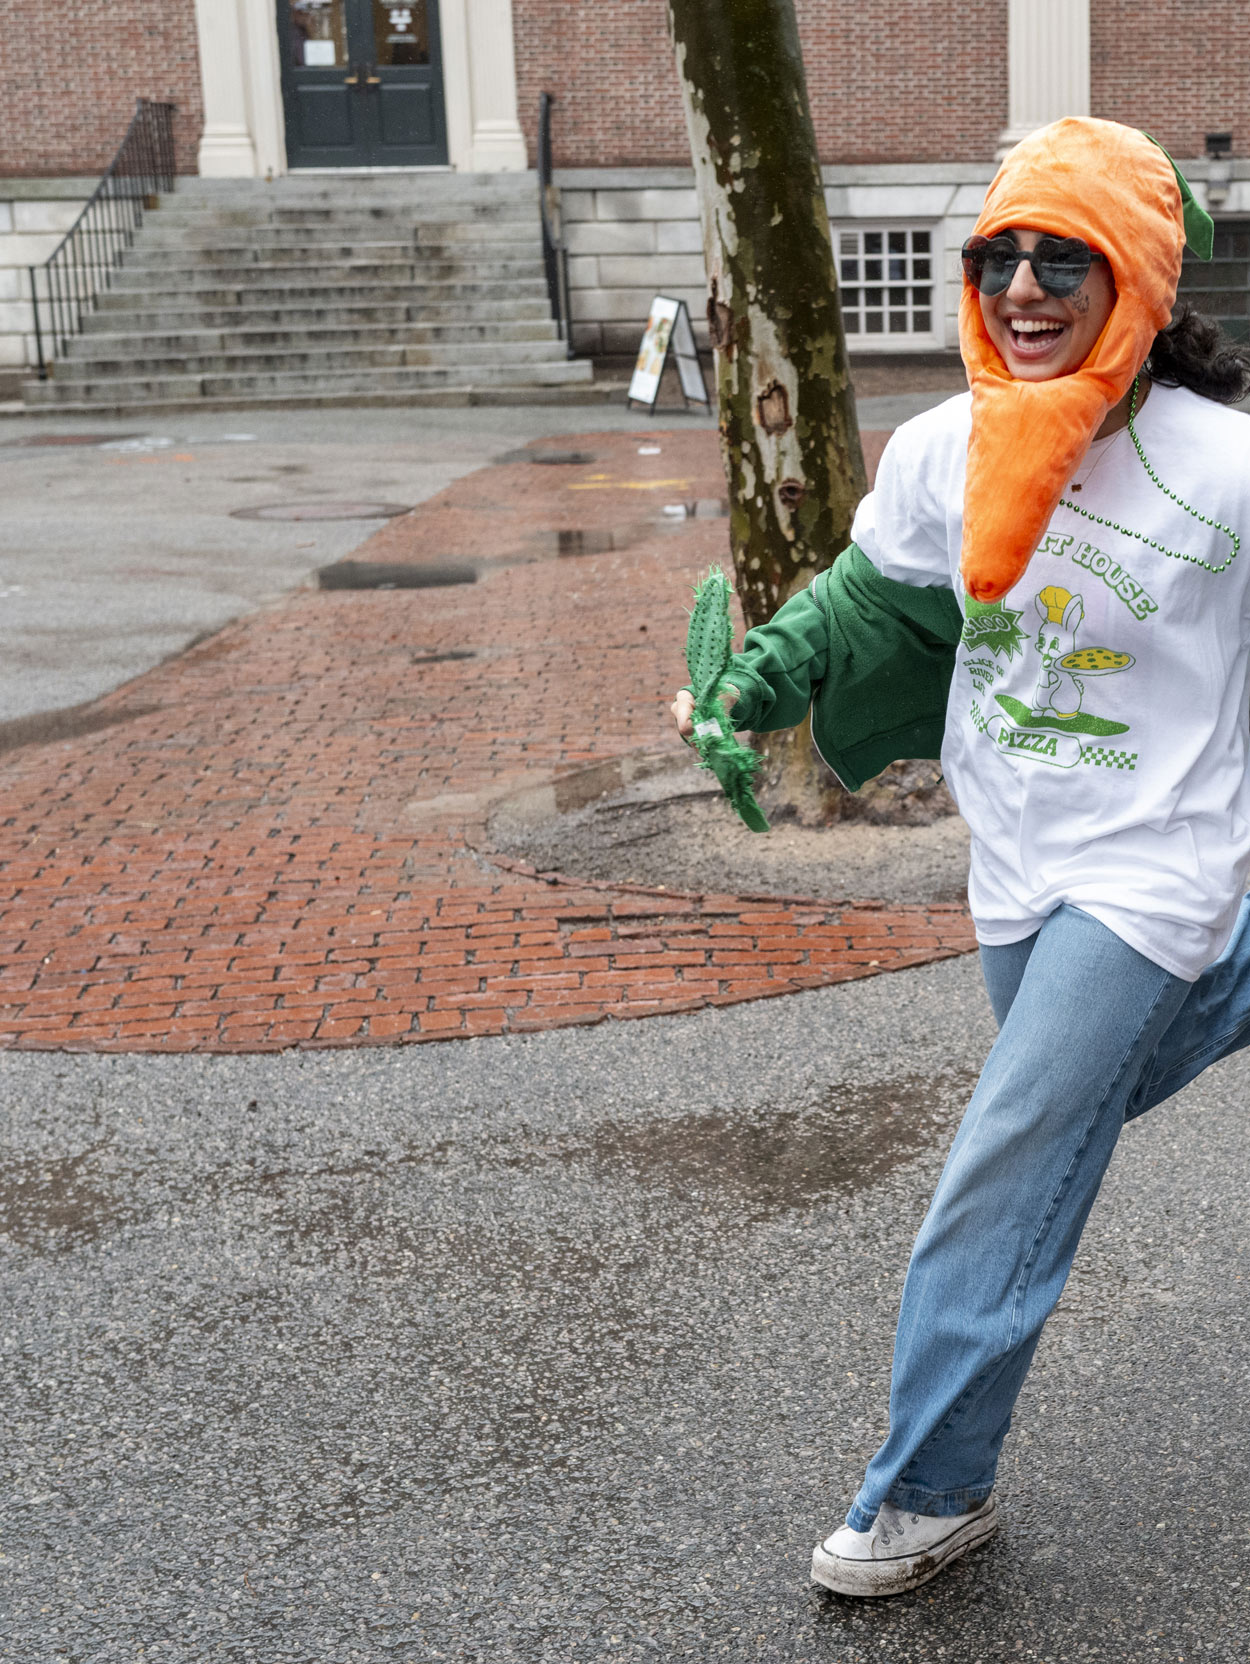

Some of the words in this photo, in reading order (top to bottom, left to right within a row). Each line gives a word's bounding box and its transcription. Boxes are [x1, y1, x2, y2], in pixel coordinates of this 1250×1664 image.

[1072, 542, 1159, 621] HOUSE
[963, 657, 995, 671] SLICE
[968, 667, 995, 687] RIVER
[998, 727, 1058, 757] PIZZA
